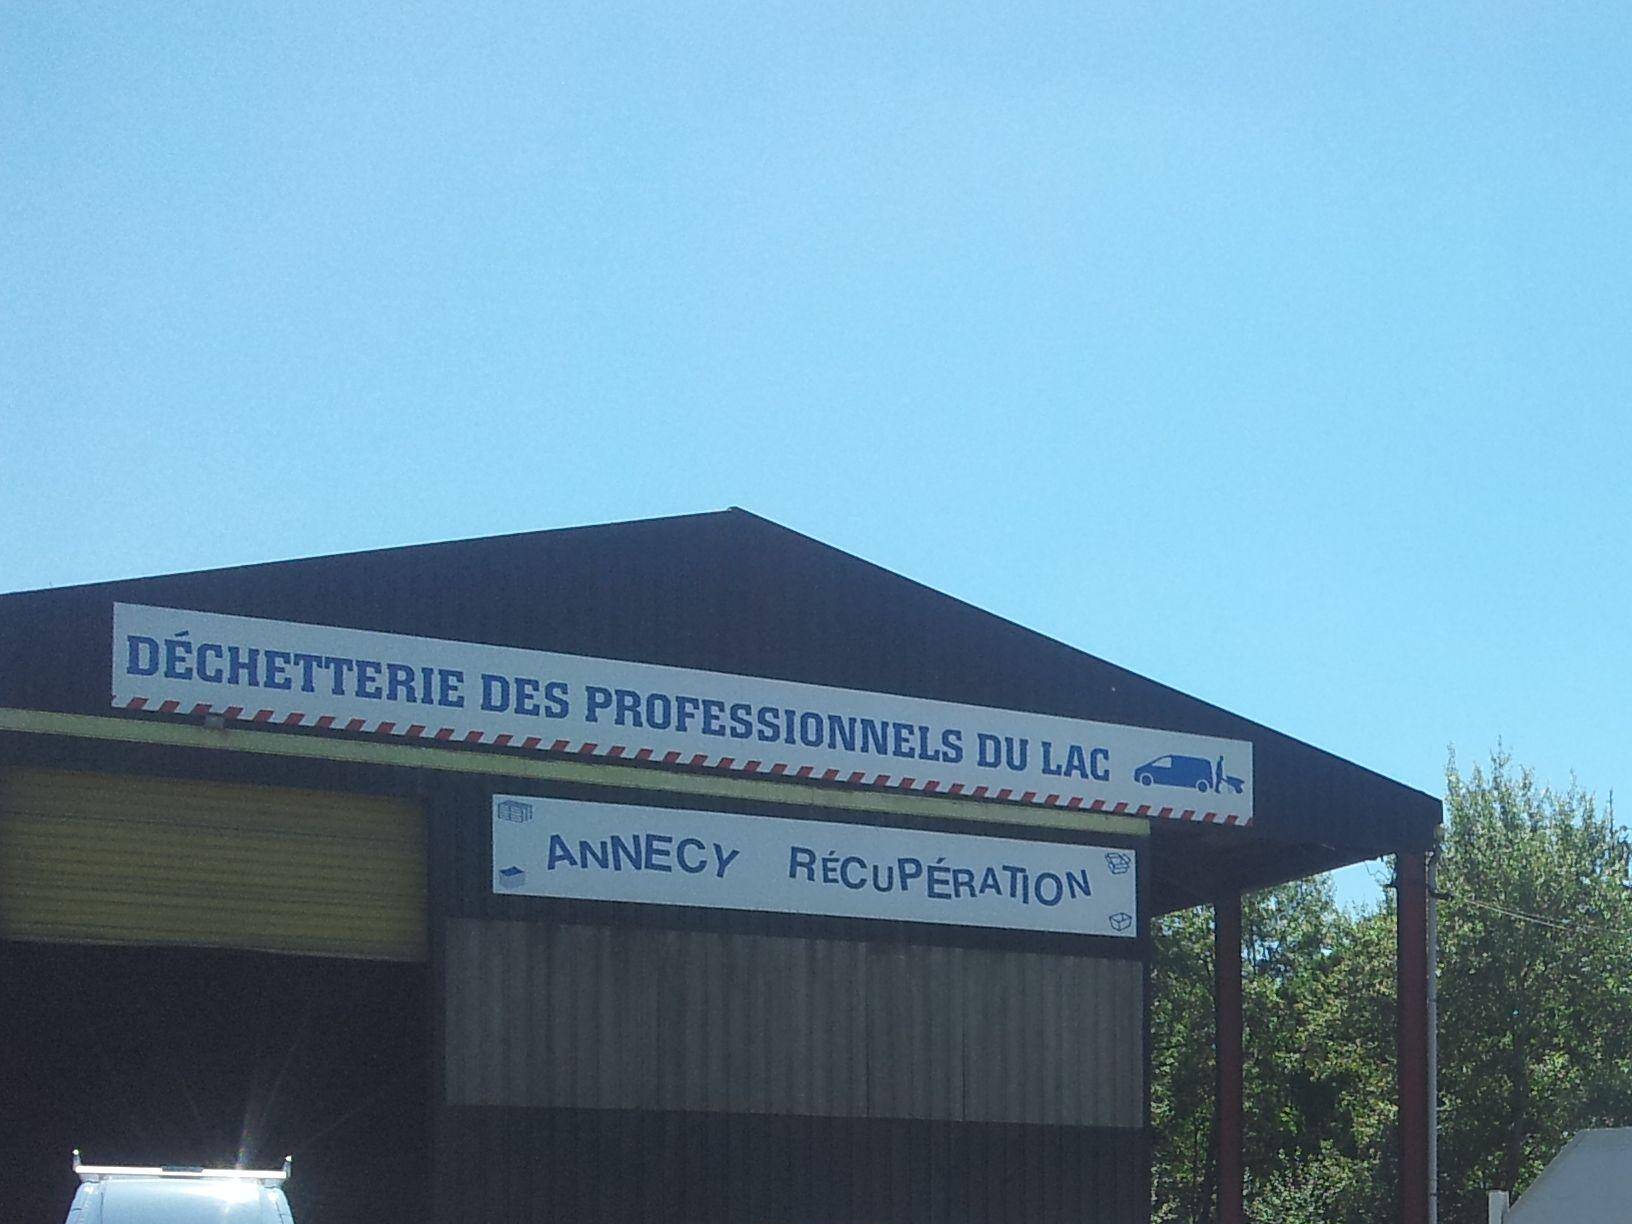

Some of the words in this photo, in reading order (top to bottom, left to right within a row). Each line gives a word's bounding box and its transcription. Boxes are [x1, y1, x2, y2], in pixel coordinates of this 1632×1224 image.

[126, 630, 465, 708] DÉCHETTERIE
[480, 673, 569, 719] DES
[585, 685, 963, 763] PROFESSIONNELS
[977, 733, 1028, 771] DU
[1041, 740, 1110, 781] LAC
[547, 833, 740, 878] ANNECY
